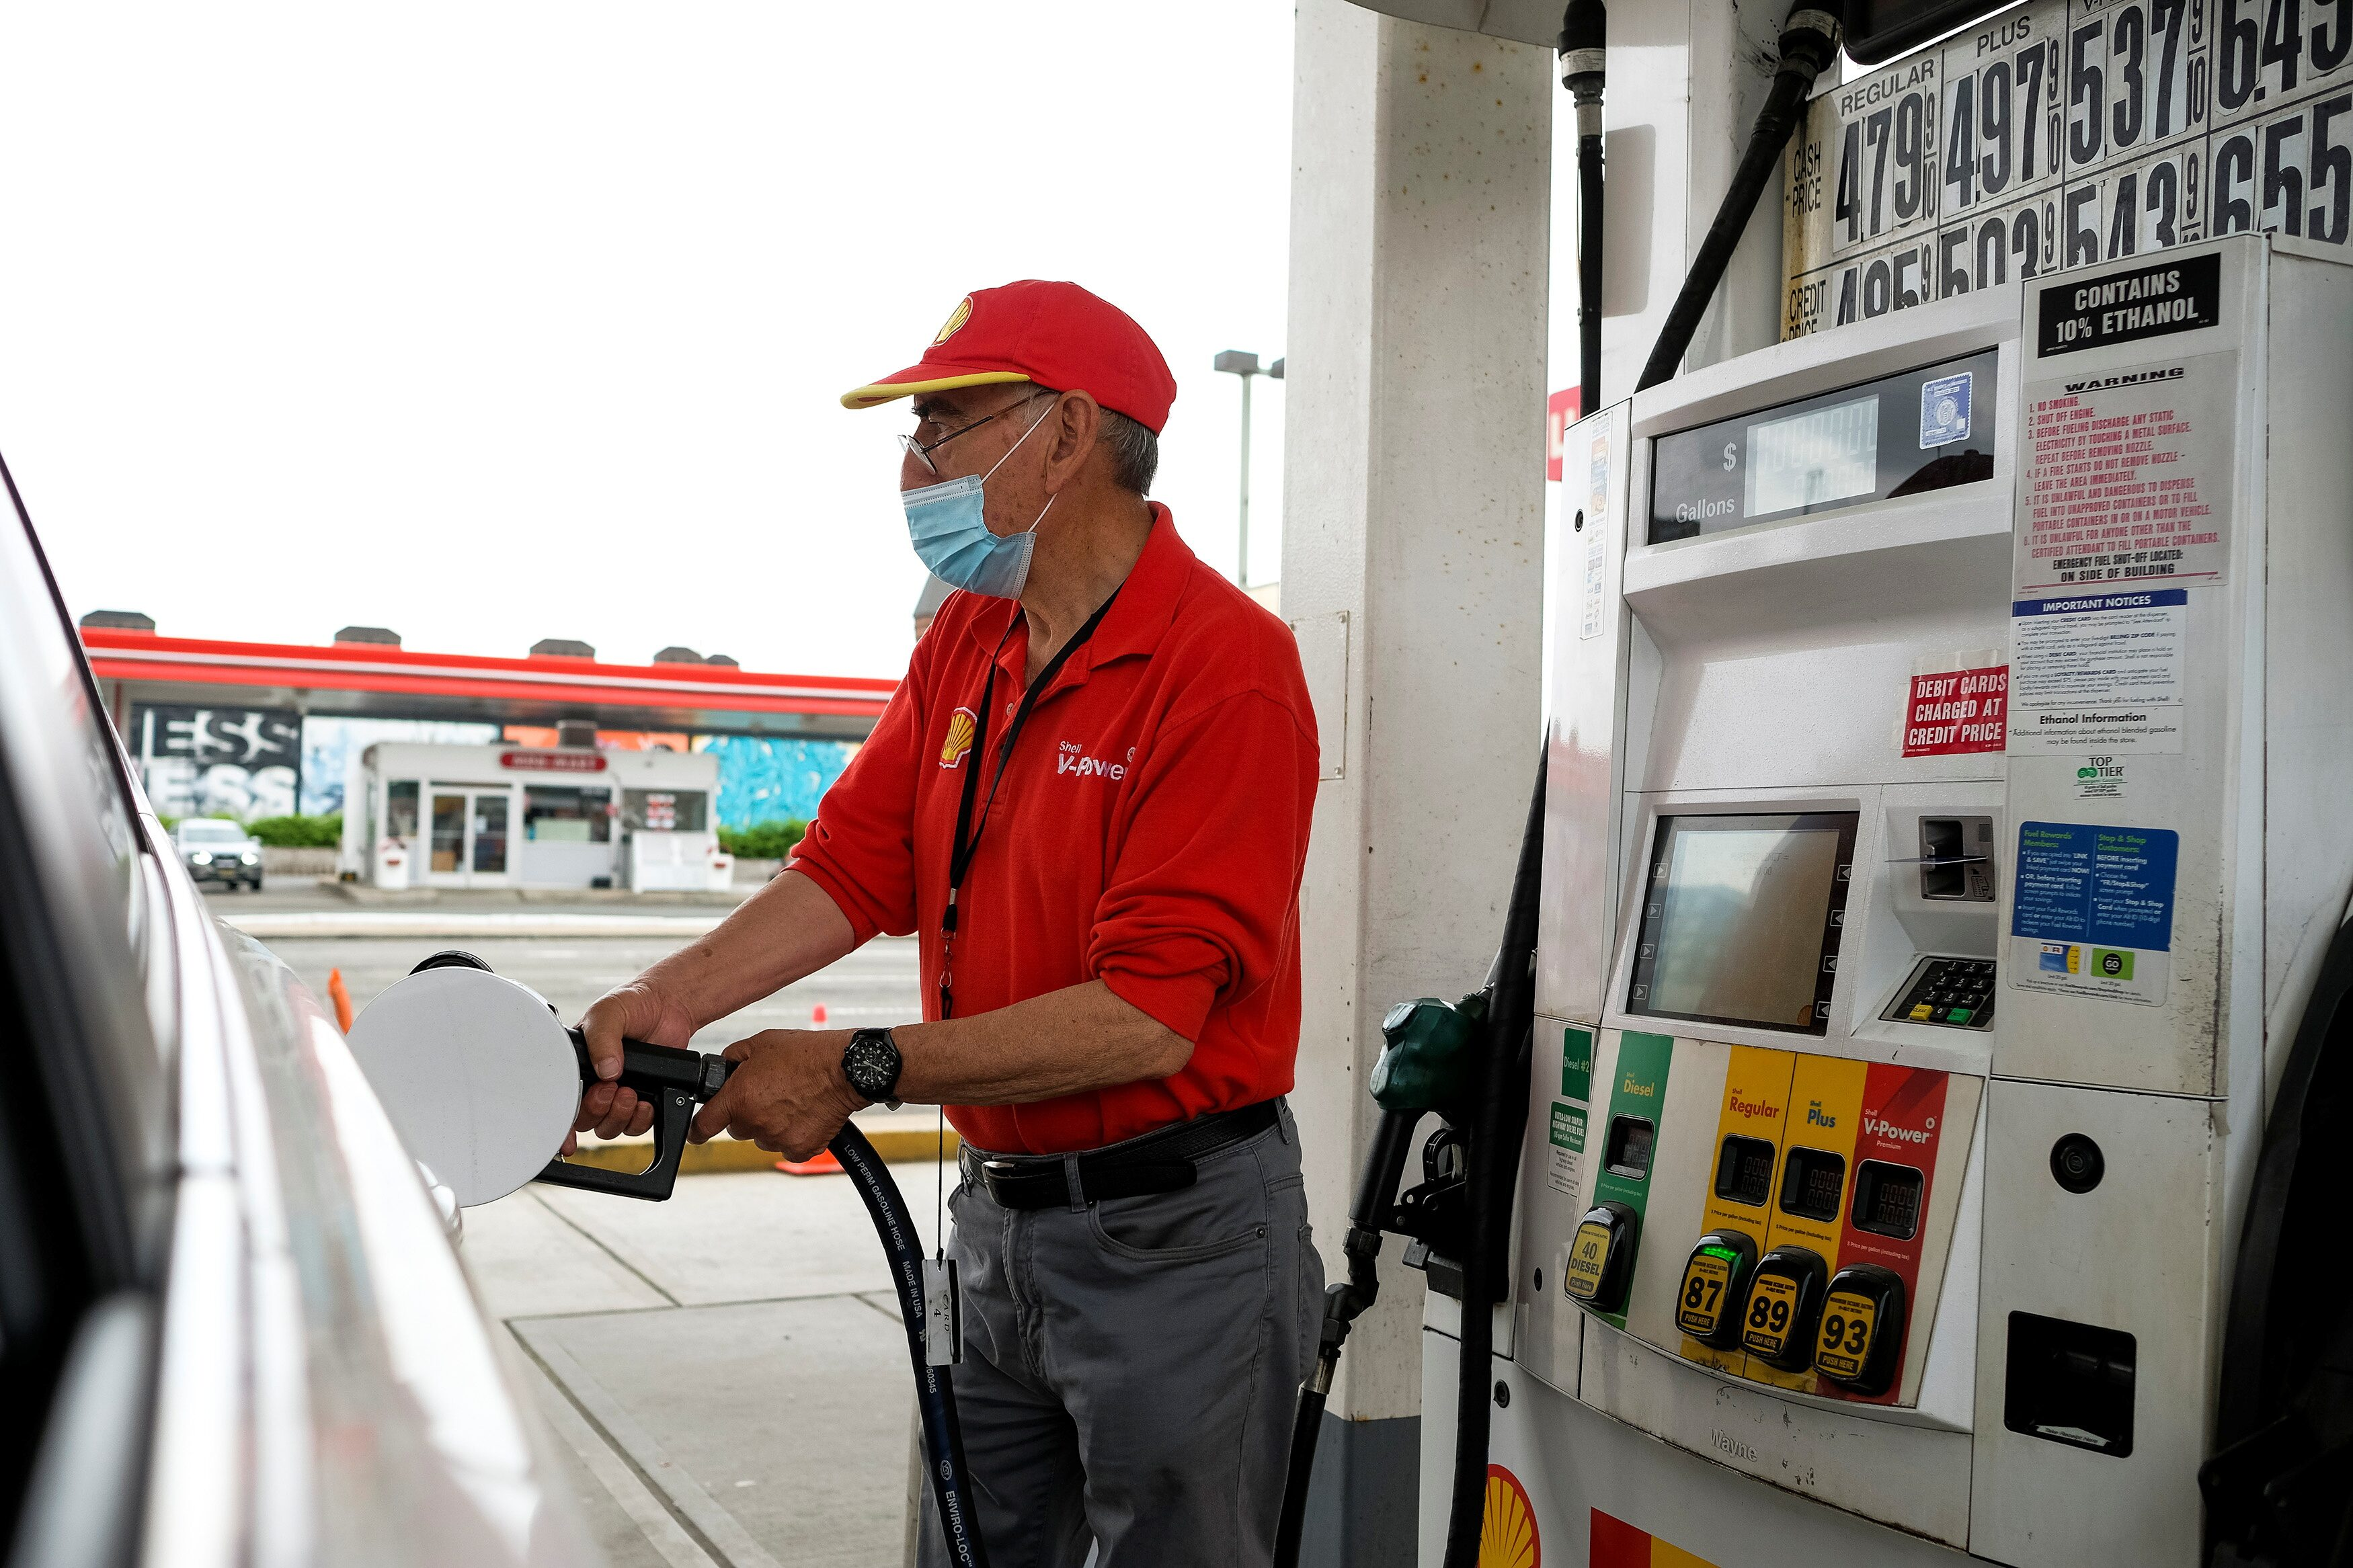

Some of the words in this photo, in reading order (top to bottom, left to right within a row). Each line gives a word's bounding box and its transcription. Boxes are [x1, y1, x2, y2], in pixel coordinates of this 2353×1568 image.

[1977, 15, 2030, 58] PLUS
[1841, 59, 1934, 118] REGULAR
[1794, 140, 1821, 183] CASH
[2212, 93, 2353, 247] 655
[1792, 176, 1822, 218] PRICE
[1789, 279, 1827, 323] CREDIT
[2075, 270, 2181, 311] CONTAINS
[2056, 316, 2093, 343] 10%
[2102, 296, 2199, 335] ETHANOL
[2064, 367, 2185, 393] WARNING
[2029, 403, 2035, 413] 1.
[2038, 401, 2046, 412] NO
[2048, 396, 2080, 411] SMOKING.
[2028, 415, 2035, 427] 2.
[2037, 413, 2055, 425] SHUT
[2056, 411, 2068, 423] OFF
[2070, 407, 2096, 421] ENGINE.
[2028, 429, 2034, 440] 3.
[2036, 425, 2061, 439] BEFORE
[2063, 421, 2089, 435] FUELING
[2091, 416, 2130, 431] DISCHARGE
[2132, 413, 2147, 426] ANY
[2149, 410, 2174, 423] STATIC
[2036, 437, 2076, 452] ELECTRICITY
[2077, 435, 2087, 447] BY
[2089, 430, 2122, 445] TOUCHING
[2124, 429, 2130, 440] A
[2132, 426, 2155, 439] METAL
[2157, 422, 2192, 436] SURFACE.
[1723, 442, 1737, 472] $
[2036, 452, 2059, 465] REPEAT
[2062, 449, 2086, 462] BEFORE
[2089, 444, 2123, 458] REMOVING
[2126, 440, 2154, 454] NOZZLE.
[2034, 480, 2053, 492] LEAVE
[2056, 478, 2068, 489] THE
[2070, 476, 2088, 489] AREA
[2090, 470, 2137, 485] IMMEDIATELY.
[1675, 497, 1735, 524] Gallons
[2033, 507, 2048, 518] FUEL
[2050, 505, 2065, 517] INTO
[2067, 501, 2111, 515] UNAPPROVED
[2113, 495, 2156, 510] CONTAINERS
[2159, 494, 2169, 505] OR
[2171, 493, 2181, 504] TO
[2183, 491, 2198, 503] FILL
[2052, 556, 2093, 571] EMERGENCY
[2094, 554, 2111, 567] FUEL
[2113, 551, 2149, 566] SHUT-OFF
[2149, 548, 2184, 563] LOCATED:
[2061, 571, 2075, 583] ON
[2079, 569, 2104, 581] SIDE
[2107, 567, 2121, 579] OF
[2124, 563, 2176, 578] BUILDING
[2042, 599, 2103, 612] IMPORTANT
[2105, 595, 2151, 608] NOTICES
[1916, 678, 1958, 700] DEBIT
[1960, 672, 2007, 696] CARDS
[1915, 700, 1978, 723] CHARGED
[1982, 697, 2003, 717] AT
[2040, 715, 2079, 725] Ethanol
[2082, 712, 2147, 724] Information
[1908, 725, 1958, 747] CREDIT
[1960, 722, 2003, 743] PRICE
[2012, 729, 2042, 737] Additional
[2149, 725, 2177, 735] gasoline
[1059, 741, 1082, 754] Shell
[2089, 756, 2112, 767] TOP
[2098, 766, 2123, 778] TIER
[2024, 830, 2038, 838] Fuel
[2040, 831, 2073, 839] Rewards
[2024, 839, 2059, 848] Members:
[2098, 834, 2116, 843] Stop
[2126, 835, 2147, 845] Shop
[2098, 843, 2141, 853] Customers:
[1564, 1056, 1579, 1071] Diesel
[1581, 1060, 1590, 1073] #2
[1624, 1079, 1654, 1097] Diesel
[1729, 1096, 1780, 1118] Regular
[1552, 1120, 1566, 1130] HIGHWAY
[1566, 1122, 1577, 1133] DIESEL
[1577, 1126, 1585, 1137] FUEL
[1554, 1111, 1571, 1122] ULTRA-LOW
[1571, 1115, 1583, 1127] SULFUR
[1806, 1108, 1836, 1128] Plus
[1864, 1117, 1930, 1145] V-Power
[1876, 1140, 1901, 1151] Premium
[844, 1145, 861, 1163] LOW
[857, 1161, 875, 1186] PERM
[872, 1185, 896, 1227] GASOLINE
[890, 1226, 906, 1251] HOSE
[1581, 1241, 1597, 1260] 40
[1880, 1248, 1901, 1259] (including
[902, 1260, 916, 1286] MADE
[1570, 1257, 1600, 1276] DIESEL
[910, 1286, 919, 1298] IN
[1570, 1278, 1581, 1286] Push
[1581, 1280, 1592, 1290] Here
[1685, 1276, 1724, 1313] 87
[912, 1297, 923, 1319] USA
[933, 1308, 942, 1318] 4
[1749, 1295, 1790, 1333] 89
[1684, 1313, 1698, 1323] PUSH
[1698, 1317, 1710, 1327] HERE
[1749, 1333, 1762, 1344] PUSH
[1763, 1336, 1778, 1348] HERE
[1823, 1314, 1868, 1355] 93
[1822, 1355, 1839, 1366] PUSH
[1839, 1359, 1854, 1370] HERE
[2044, 1427, 2059, 1435] Take
[1711, 1428, 1758, 1462] Wayne
